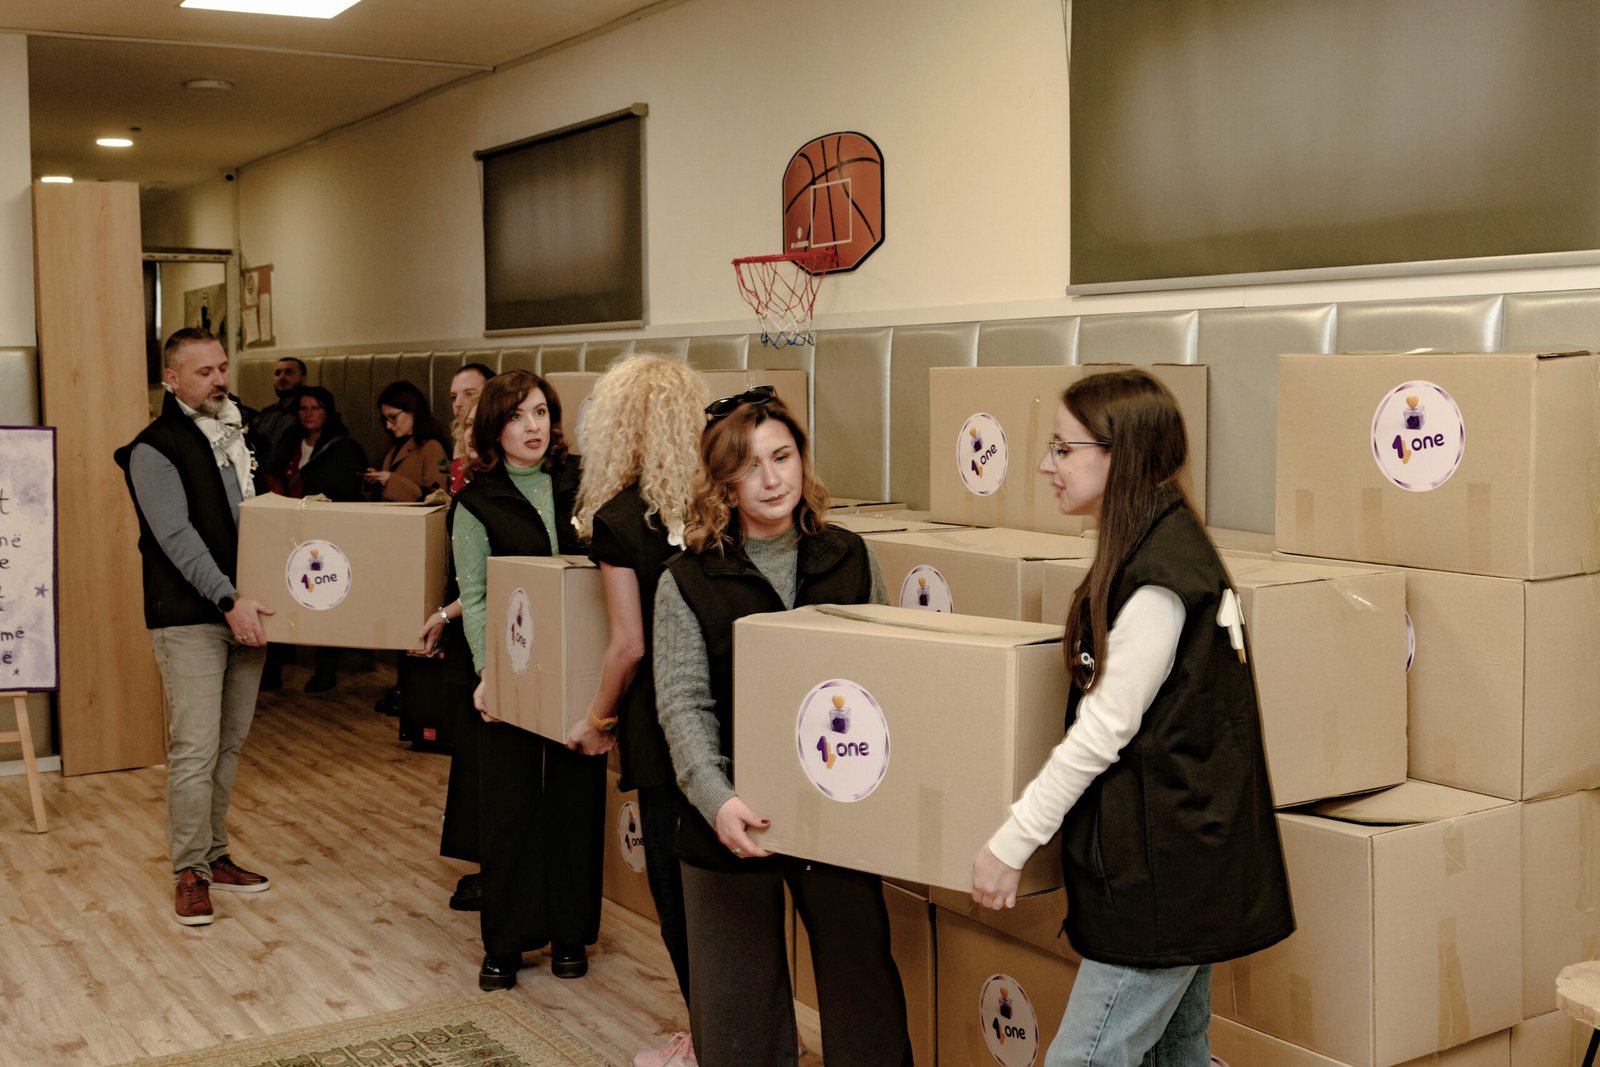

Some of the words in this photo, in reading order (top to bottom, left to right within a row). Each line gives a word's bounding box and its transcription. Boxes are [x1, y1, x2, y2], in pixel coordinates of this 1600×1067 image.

[1411, 433, 1445, 452] one
[980, 443, 999, 466] one
[314, 573, 338, 585] one
[836, 741, 870, 757] one
[1004, 1025, 1027, 1041] one
